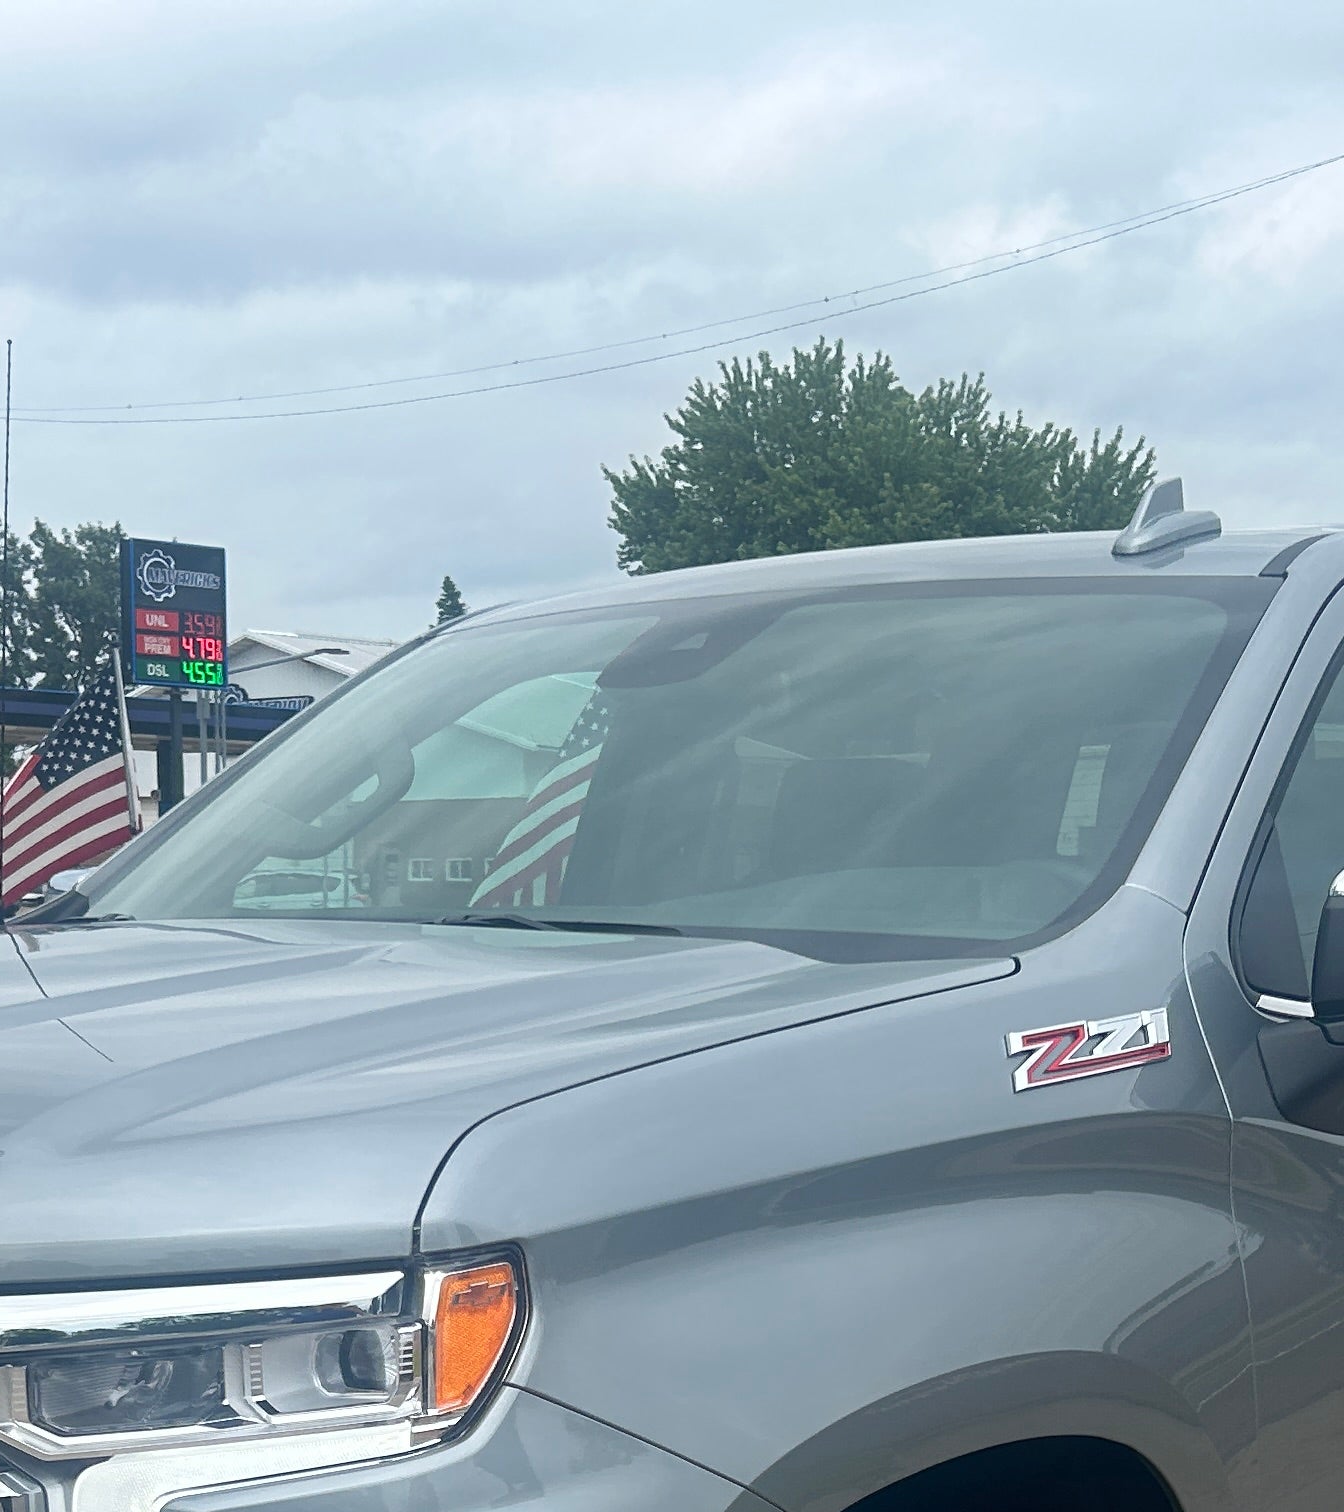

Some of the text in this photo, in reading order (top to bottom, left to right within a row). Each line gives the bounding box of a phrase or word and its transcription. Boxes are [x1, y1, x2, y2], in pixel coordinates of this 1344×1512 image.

[146, 613, 169, 628] UNL
[146, 663, 170, 677] DSL
[1004, 1007, 1172, 1093] Z71
